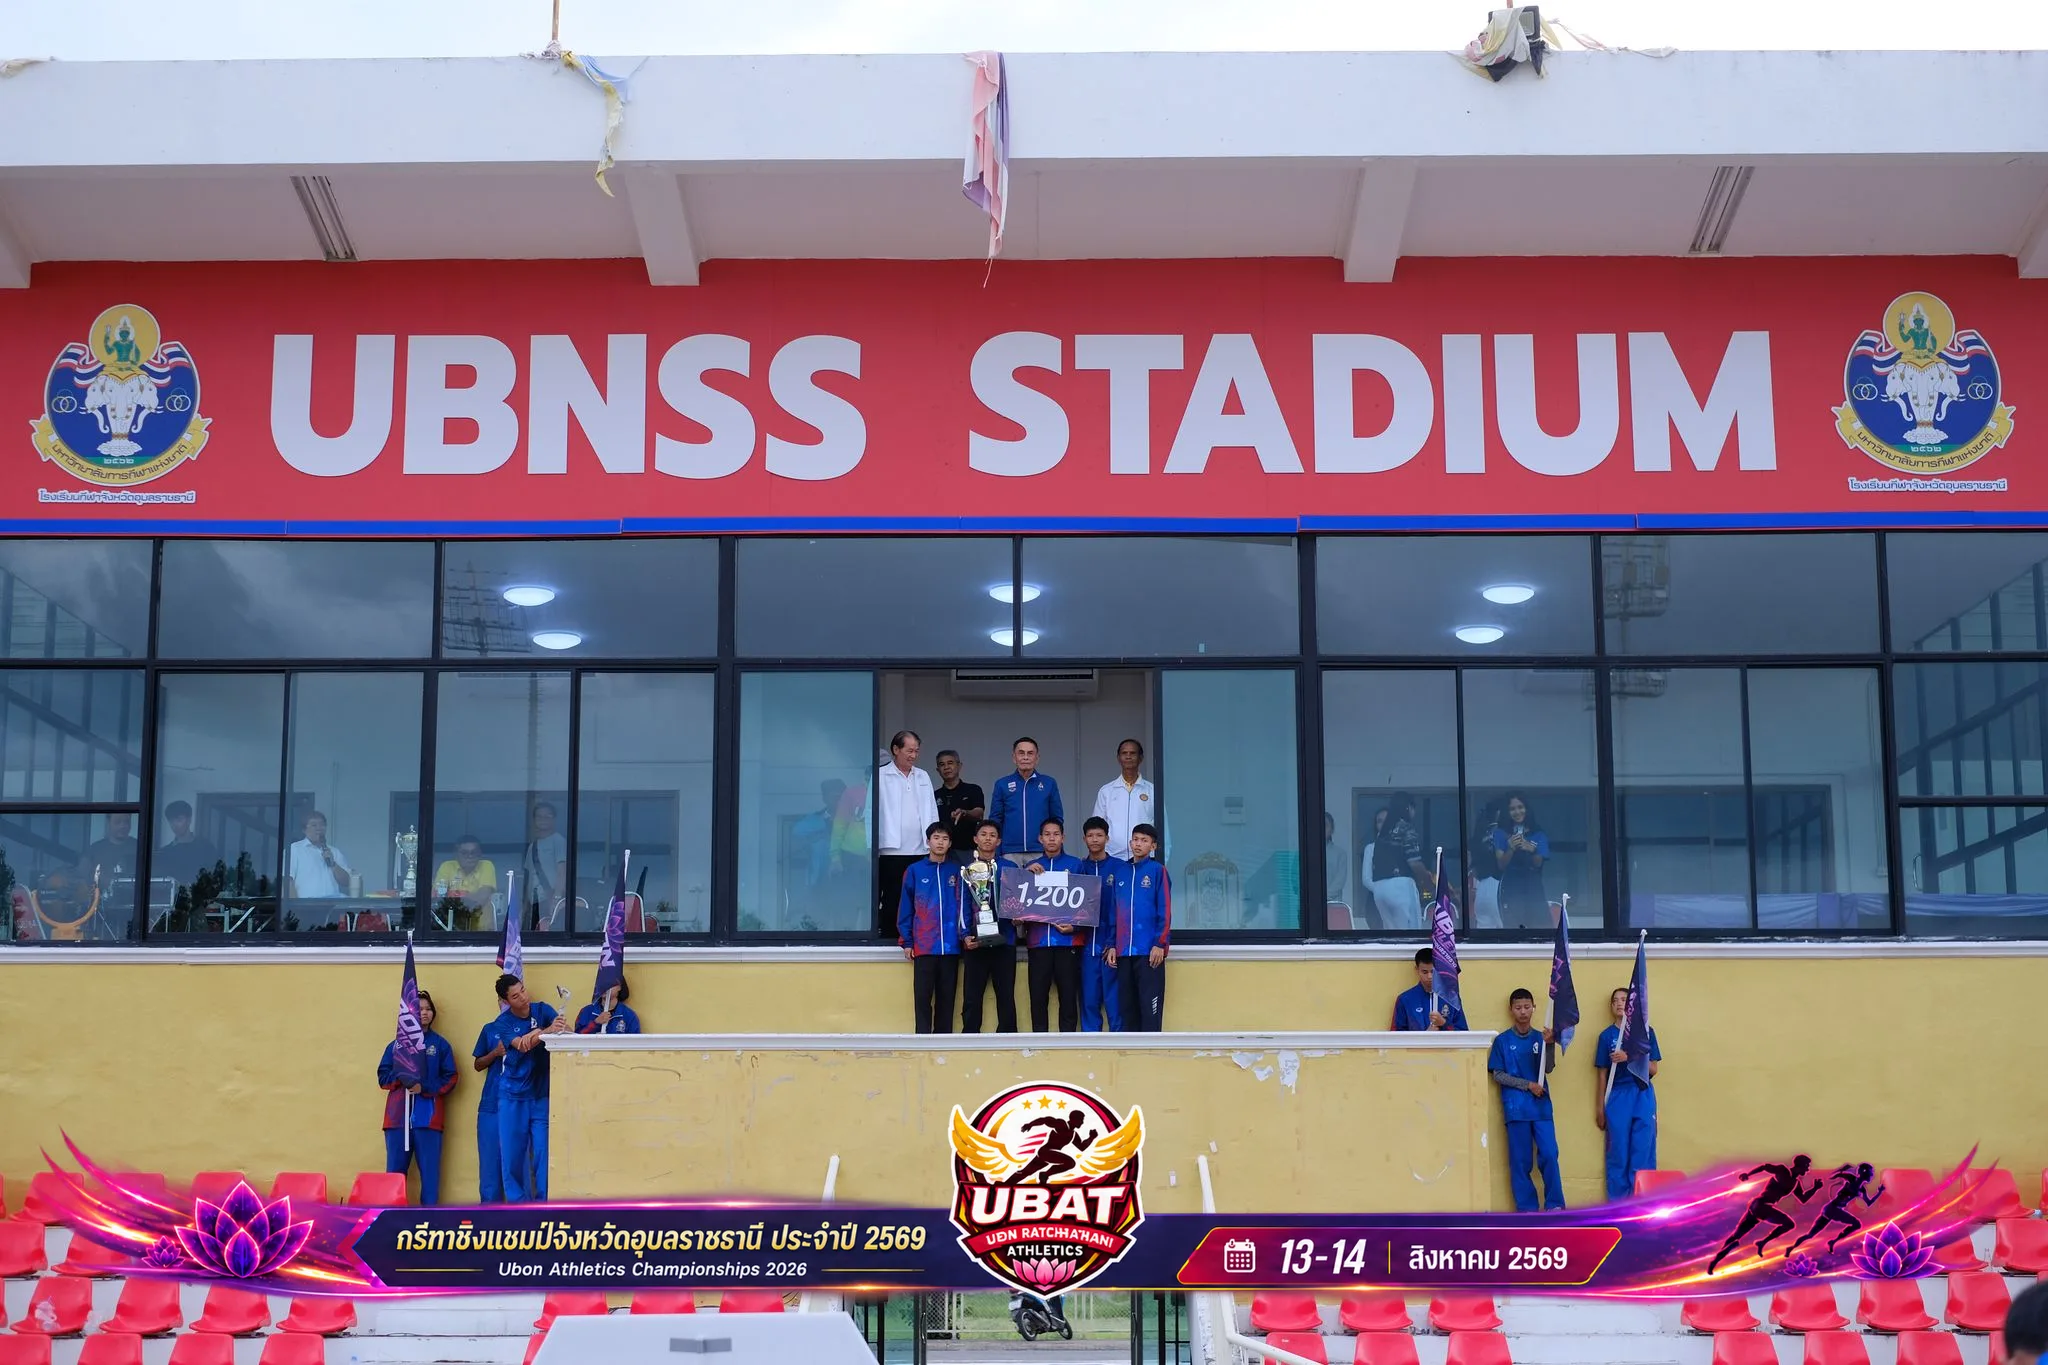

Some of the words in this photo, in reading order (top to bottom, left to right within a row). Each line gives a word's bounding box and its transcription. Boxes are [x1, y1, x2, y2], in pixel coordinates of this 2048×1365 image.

[270, 332, 867, 480] UBNSS
[968, 331, 1777, 477] STADIUM
[51, 444, 189, 481] มหาวิทยาลัยการกีฬาแห่งชาติ
[1857, 431, 1994, 468] มหาวิทยาลัยการกีฬาแห่งชาติ
[38, 489, 196, 505] โรงเรียนกีฬาจังหวัดอุบลราชธานี
[1849, 478, 2007, 493] โรงเรียนกีฬาจังหวัดอุบลราชธานี
[1017, 881, 1086, 909] 1,200
